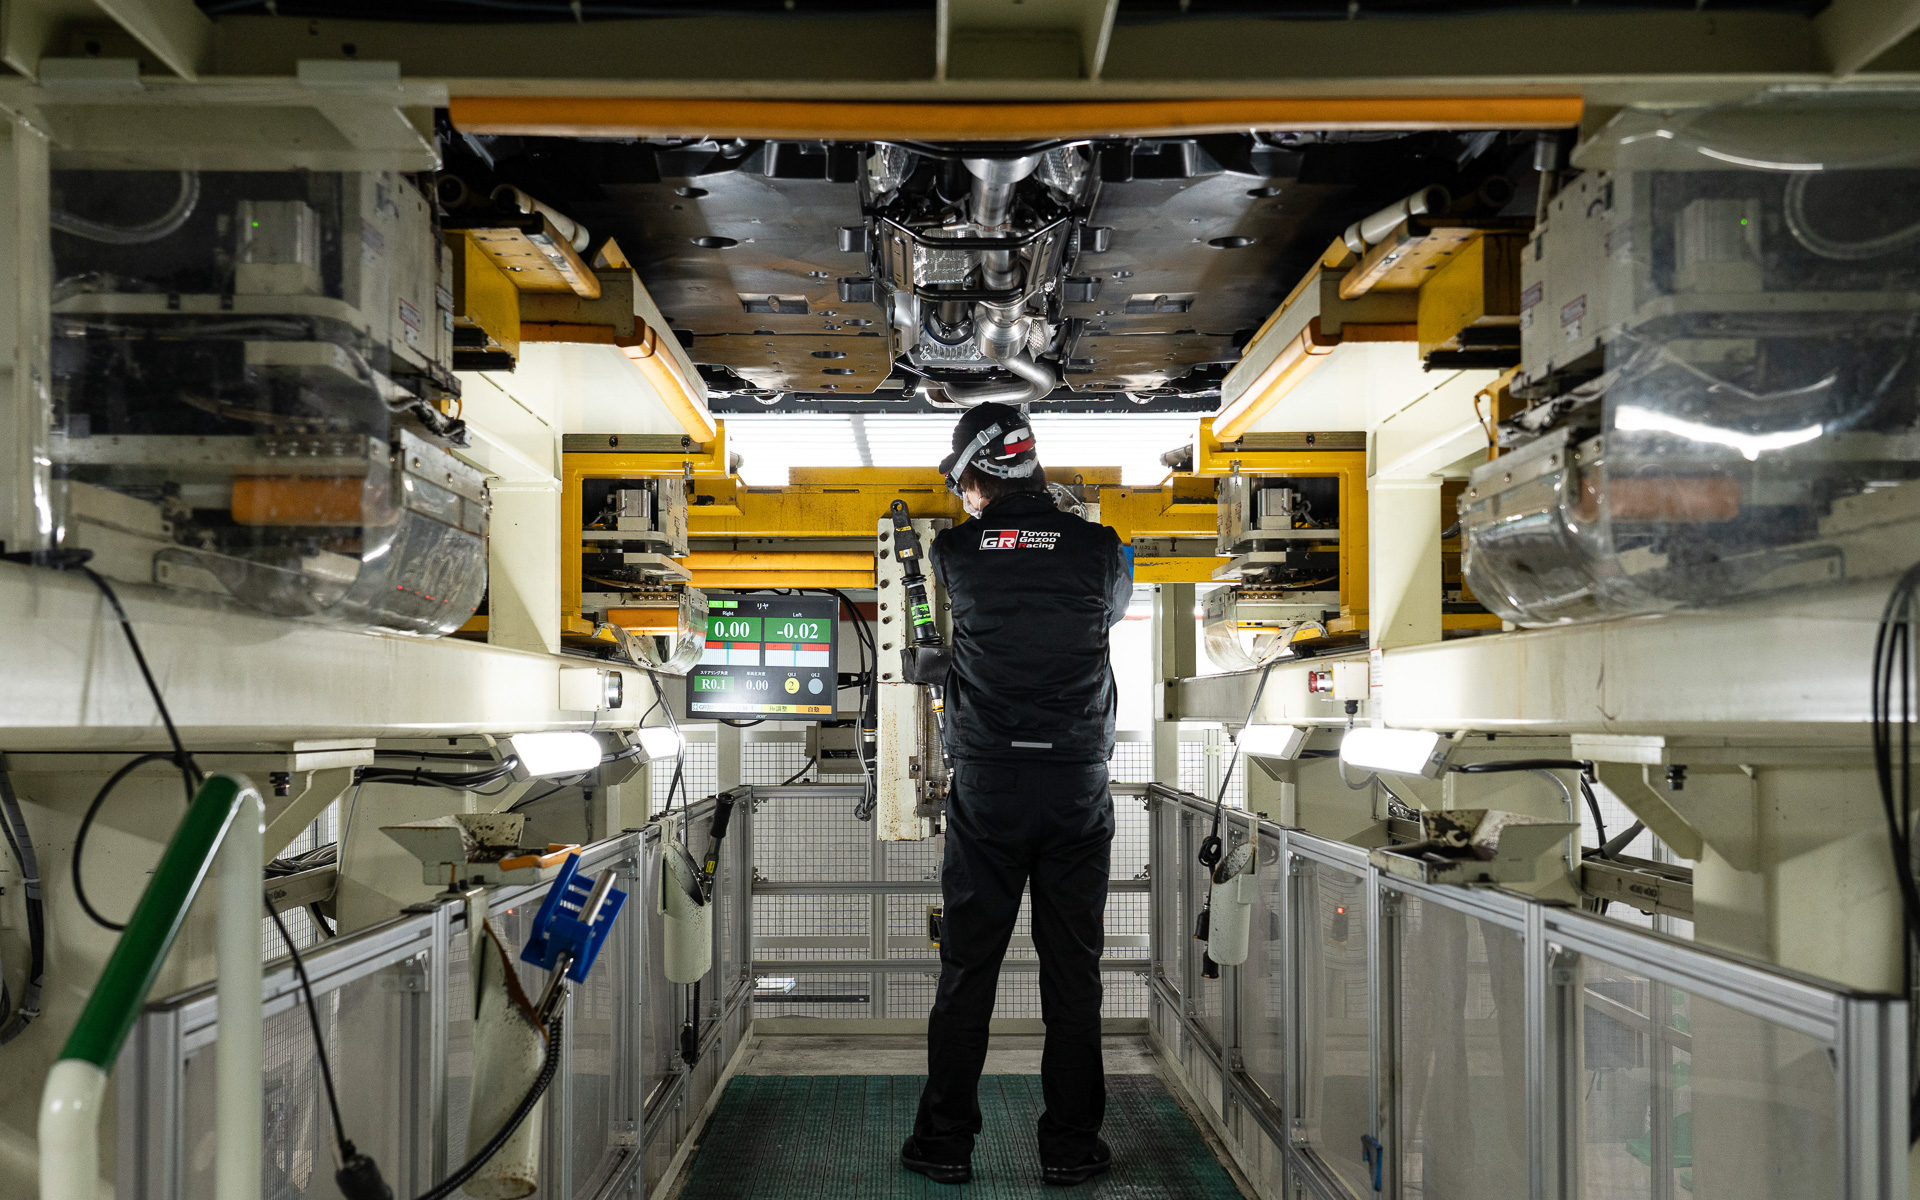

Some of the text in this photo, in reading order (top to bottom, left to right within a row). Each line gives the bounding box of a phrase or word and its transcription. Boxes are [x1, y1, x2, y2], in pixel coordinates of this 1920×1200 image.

[982, 537, 1015, 548] GR
[1018, 542, 1055, 550] Racing
[714, 621, 750, 638] 0.00
[776, 622, 819, 639] -0.02
[701, 678, 726, 690] R0.1
[746, 680, 768, 690] 0.00
[788, 680, 795, 691] 2
